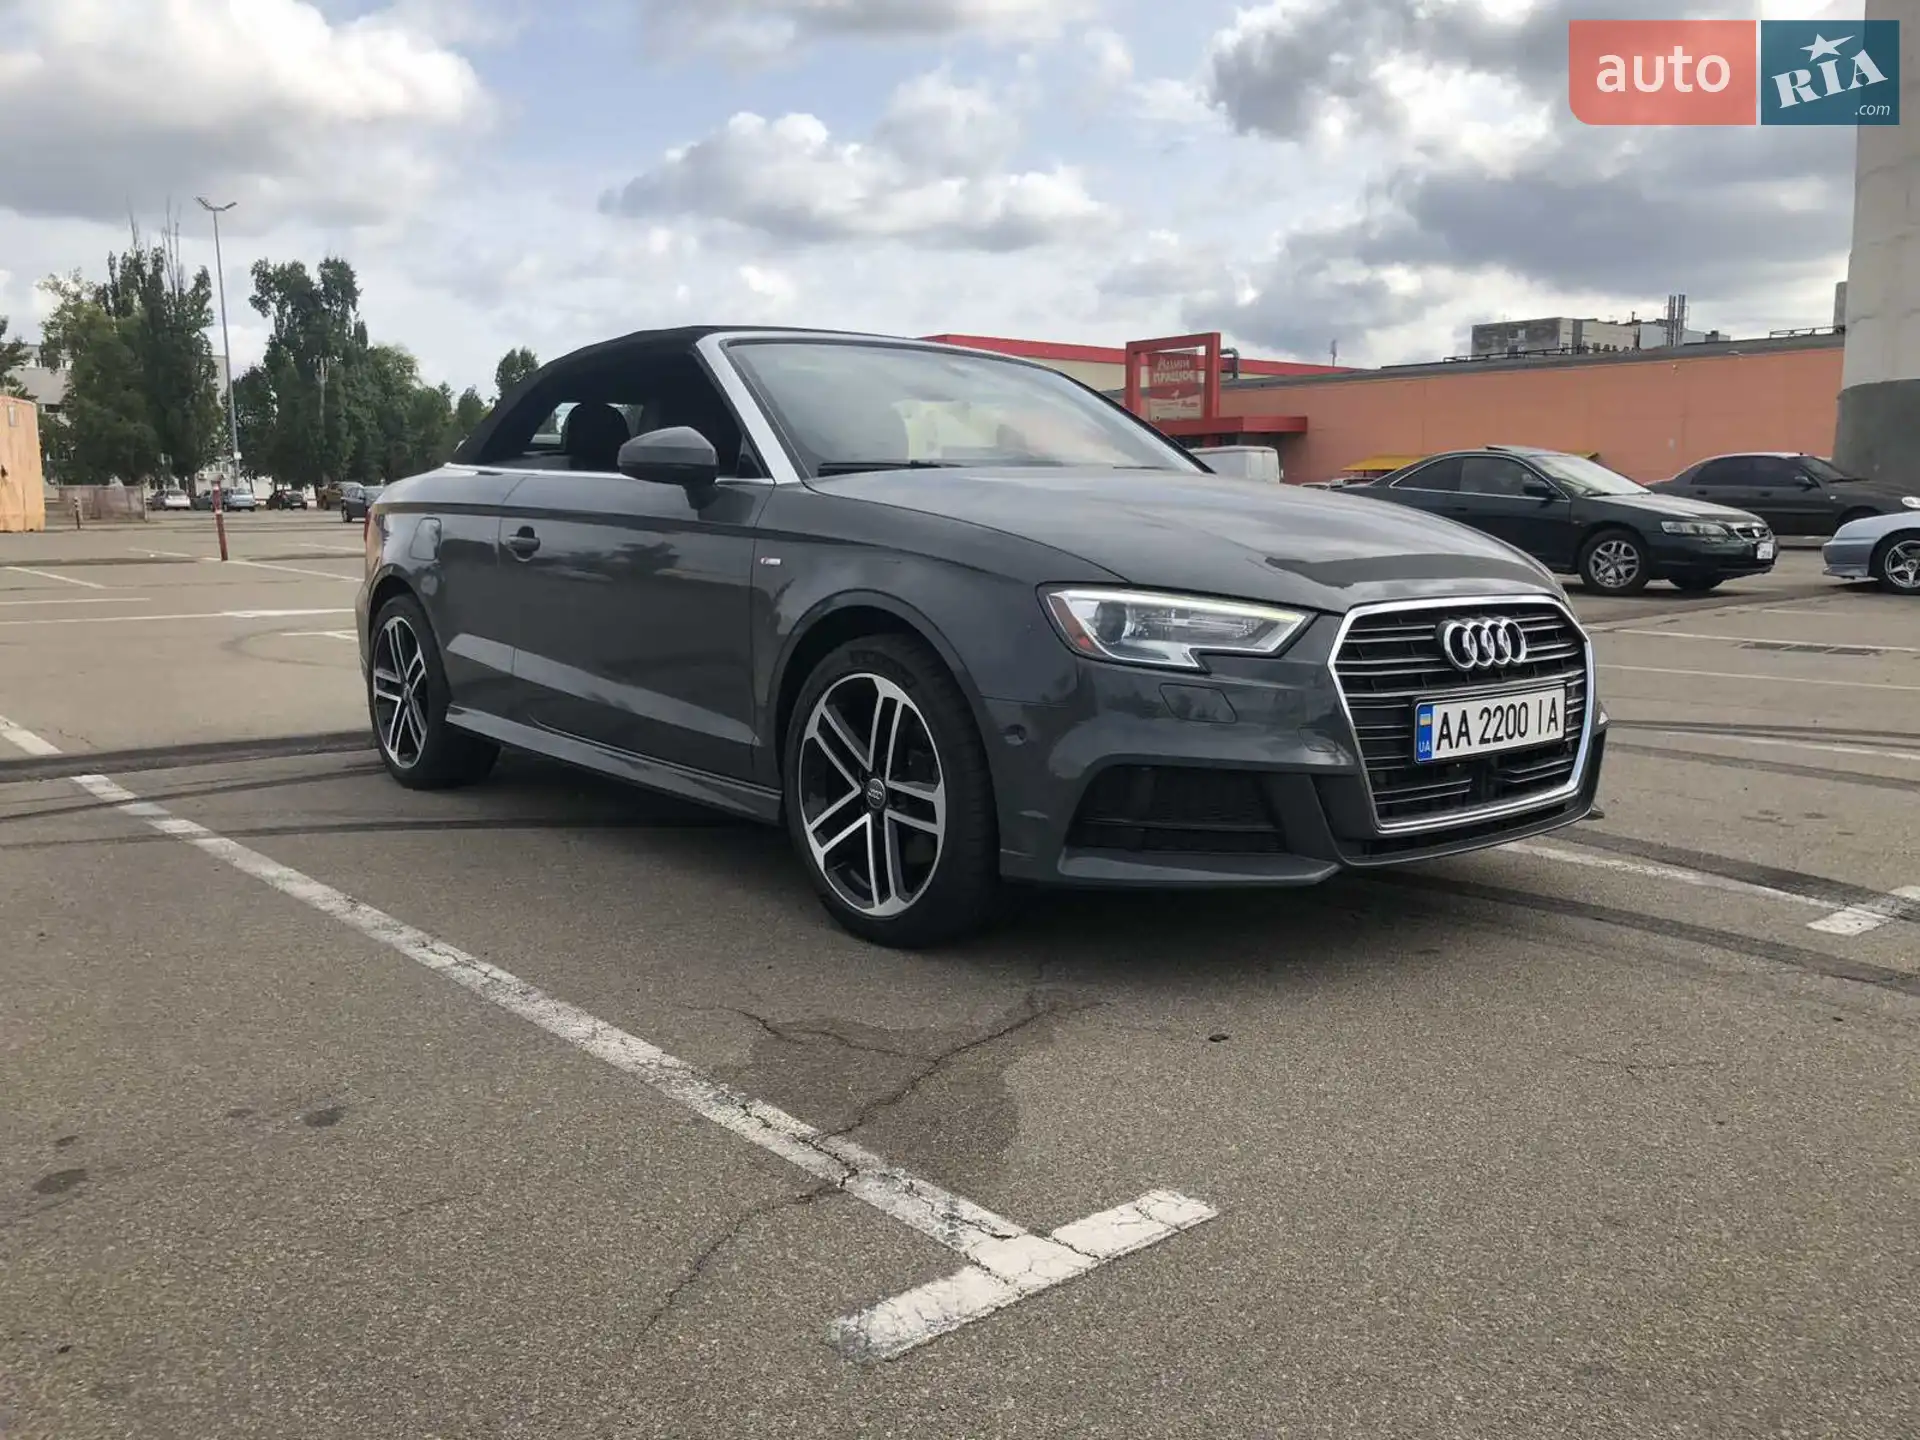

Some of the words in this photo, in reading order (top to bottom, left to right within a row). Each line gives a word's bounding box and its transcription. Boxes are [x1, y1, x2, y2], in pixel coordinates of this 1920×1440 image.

[1436, 709, 1472, 751] AA
[1478, 702, 1529, 744] 2200
[1537, 697, 1558, 735] IA
[1418, 741, 1431, 752] UA
